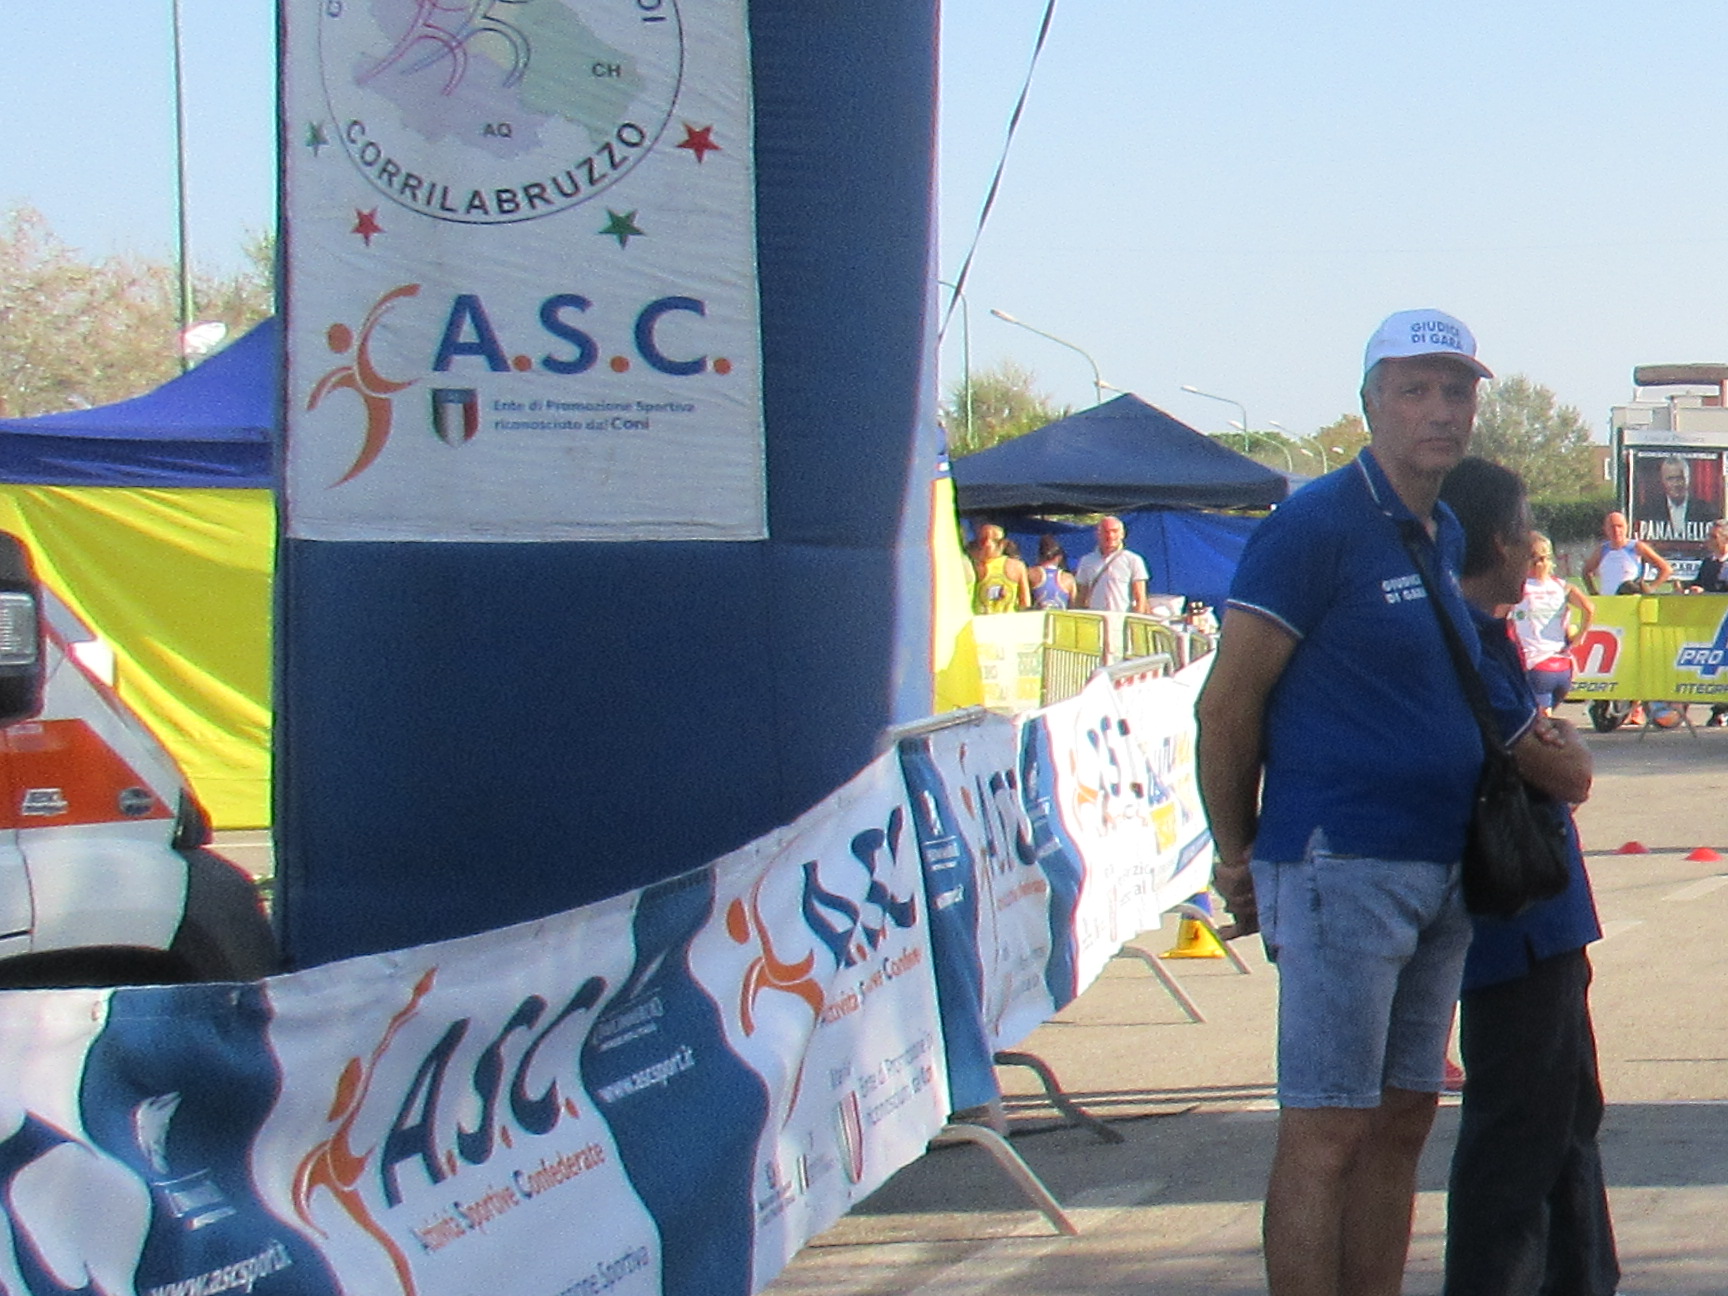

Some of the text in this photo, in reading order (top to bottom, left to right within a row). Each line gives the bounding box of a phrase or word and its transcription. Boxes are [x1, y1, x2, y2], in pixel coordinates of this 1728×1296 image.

[591, 62, 621, 77] CH
[483, 123, 513, 138] AQ
[346, 119, 647, 215] CORRILABRUZZO
[432, 293, 733, 376] A.S.C.
[1411, 333, 1426, 343] DI
[1680, 650, 1725, 665] PRO
[381, 976, 608, 1209] A.S.C.
